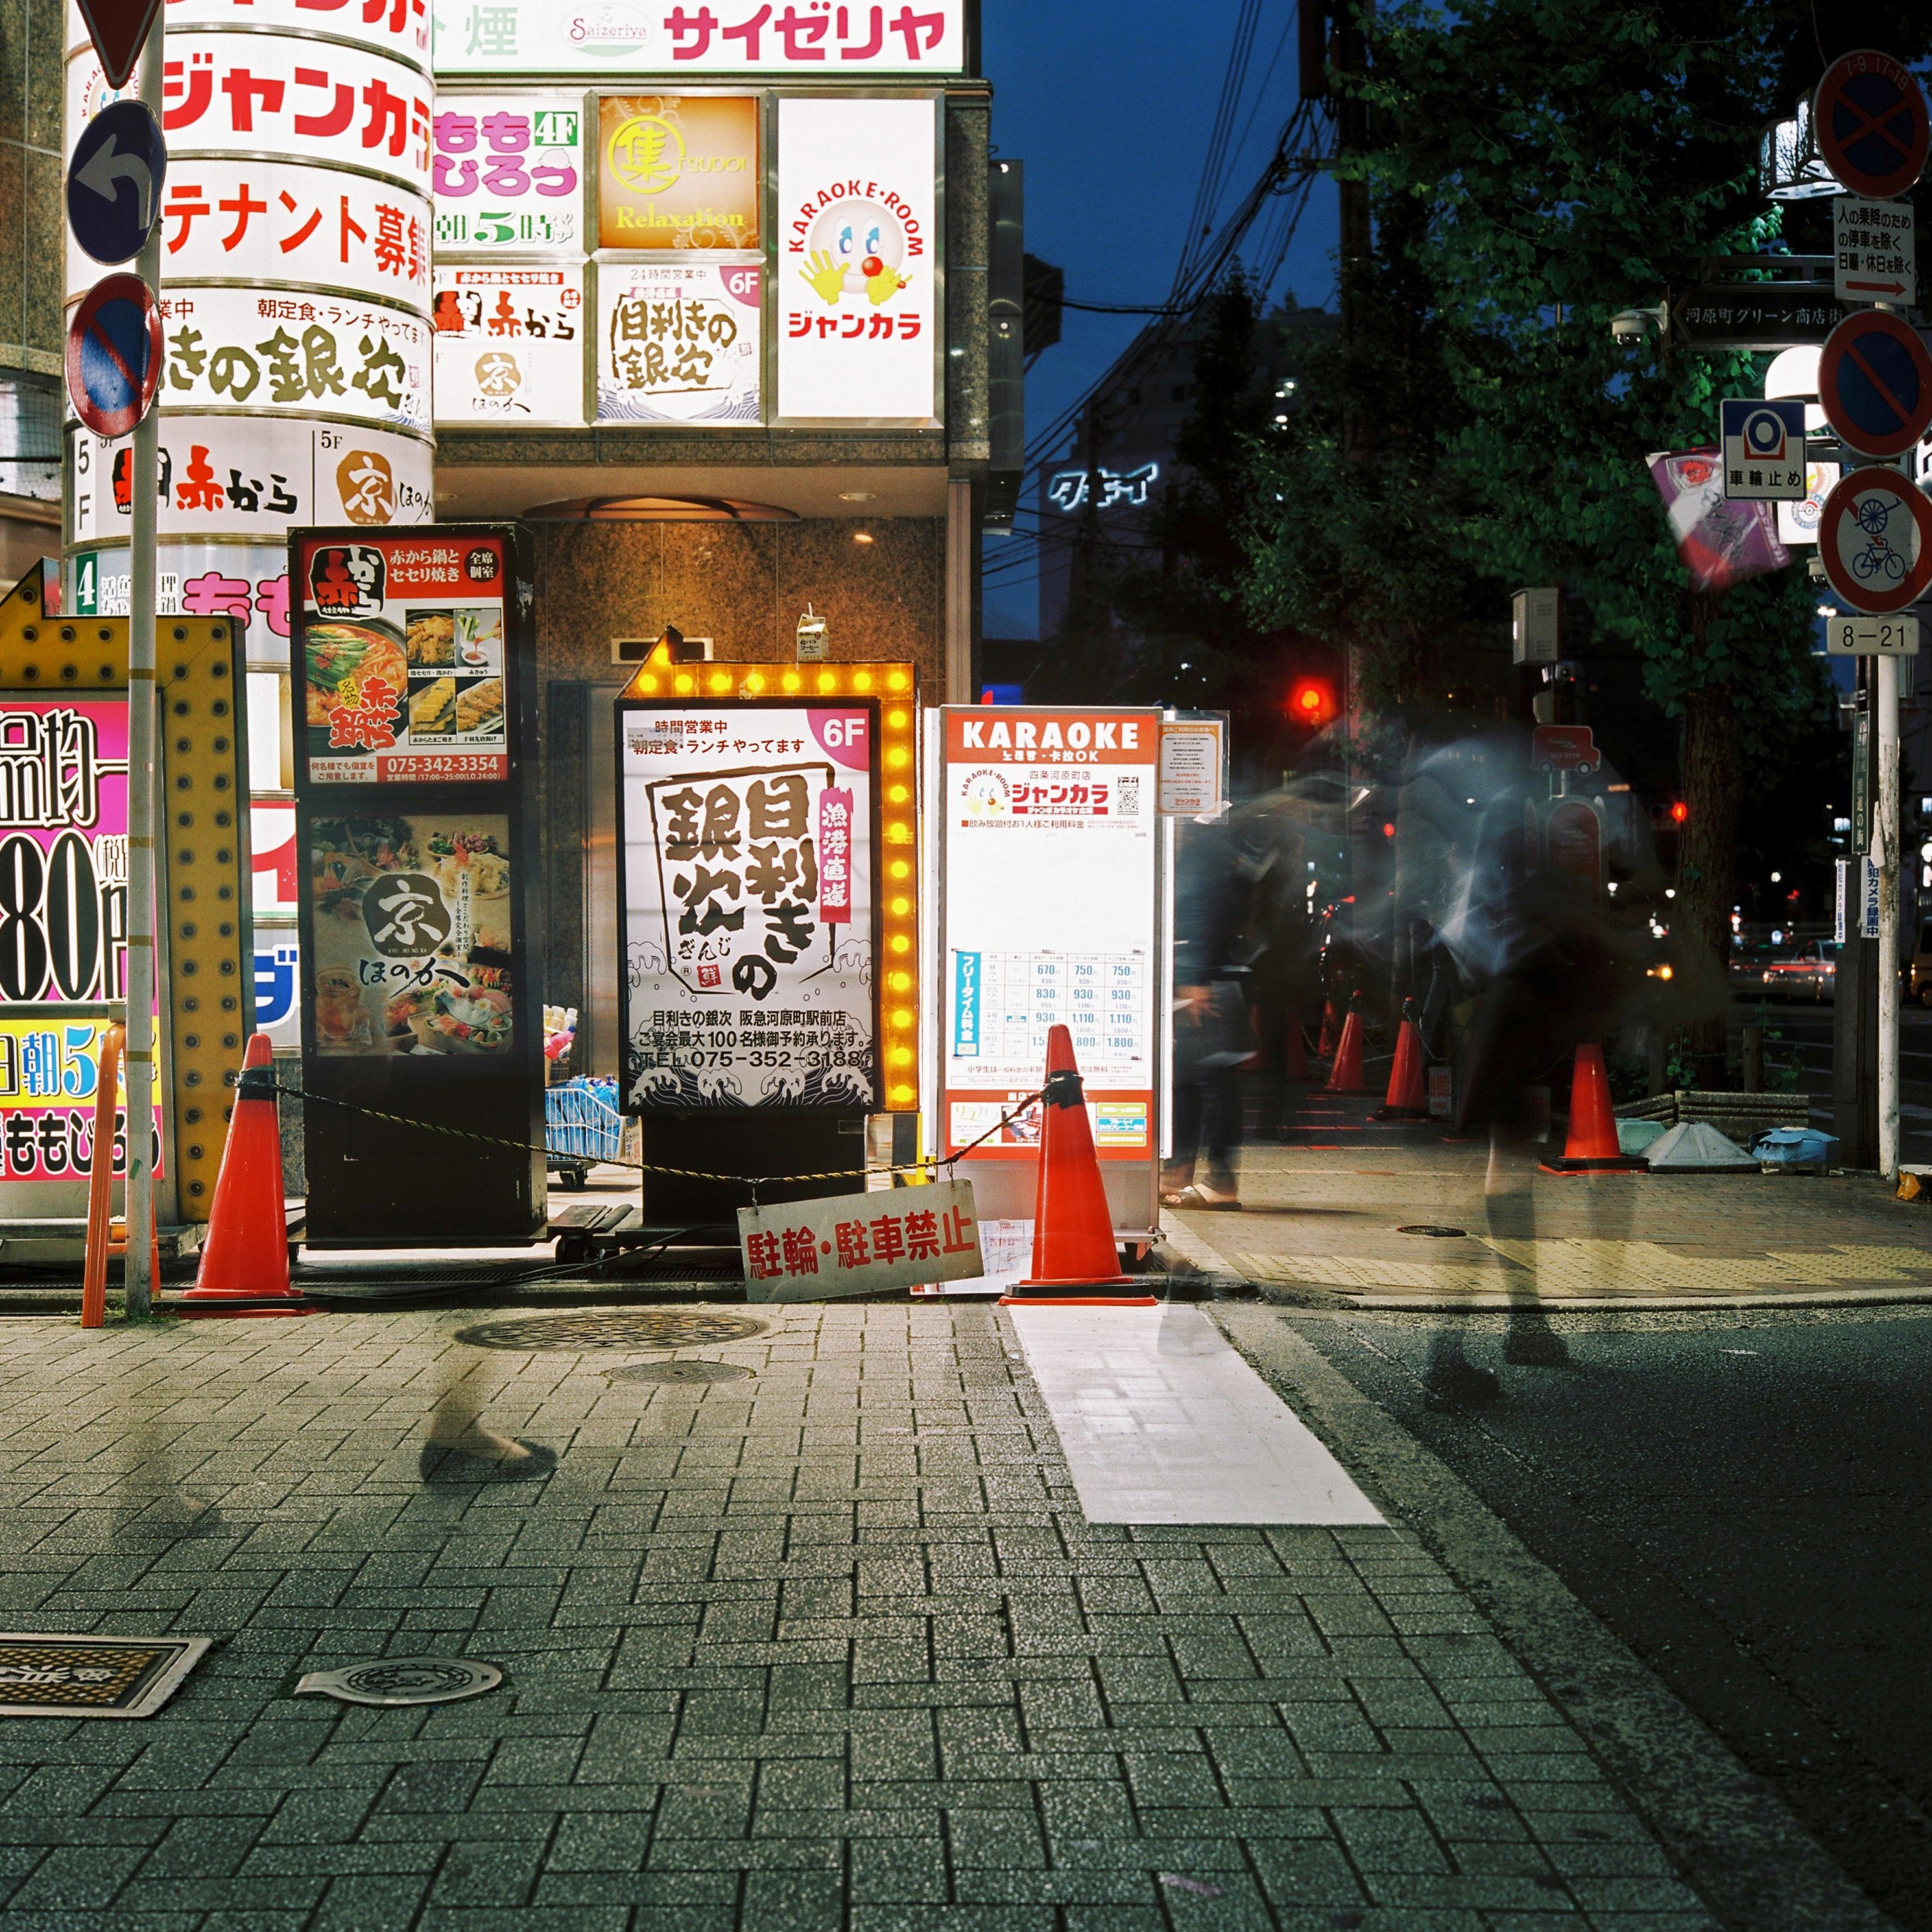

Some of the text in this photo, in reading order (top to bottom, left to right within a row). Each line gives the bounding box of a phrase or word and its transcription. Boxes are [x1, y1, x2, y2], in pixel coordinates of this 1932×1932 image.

[571, 18, 646, 40] Saizeriya
[663, 1, 944, 60] サイゼリヤ
[433, 112, 531, 153] もも
[535, 113, 577, 144] 4F
[617, 123, 672, 183] 集
[675, 156, 746, 173] TSUDOI
[433, 154, 577, 197] じろう
[615, 202, 745, 228] Relaxation
[1838, 205, 1911, 230] 人の乗降のため
[1838, 228, 1901, 252] の停車を除く
[1838, 252, 1912, 276] 日曜・休日を除く
[728, 272, 759, 294] 6F
[488, 291, 575, 340] 赤から
[620, 300, 737, 348] 目利きの
[789, 310, 921, 340] ジャンカラ
[1684, 306, 1843, 326] 河原町グリーン商店街
[160, 324, 407, 411] きの銀次
[619, 342, 713, 390] 銀次
[320, 430, 343, 449] 5F
[176, 444, 298, 514] 赤から
[1729, 470, 1802, 488] 車輪止め
[390, 549, 460, 565] 赤から鍋と
[470, 552, 494, 565] 全席
[390, 567, 460, 583] セセリ焼き
[470, 566, 494, 578] 個室
[340, 681, 359, 707] 名物
[655, 719, 728, 734] 時間営業中
[822, 718, 866, 748] 6F
[963, 721, 1139, 750] KARAOKE
[633, 738, 805, 755] 朝定食・ランチやってます
[311, 761, 375, 770] 何名様でも個室を
[318, 771, 369, 780] ご用意します。
[387, 757, 499, 773] 075-342-3354
[1029, 770, 1091, 780] 四条河原町店
[1012, 782, 1109, 804] ジャンカラ
[662, 783, 747, 937] 銀次
[820, 802, 850, 908] 漁港直送
[732, 774, 818, 1001] 目利きの
[373, 879, 444, 946] 京
[678, 936, 731, 961] ぎんじ
[359, 957, 471, 999] ほのか
[652, 1010, 846, 1027] 目利きの銀次 阪急河原町駅前店
[639, 1030, 865, 1048] ご宴会最大100名様御予約承ります。
[746, 1205, 977, 1280] 駐輪・駐車禁止
